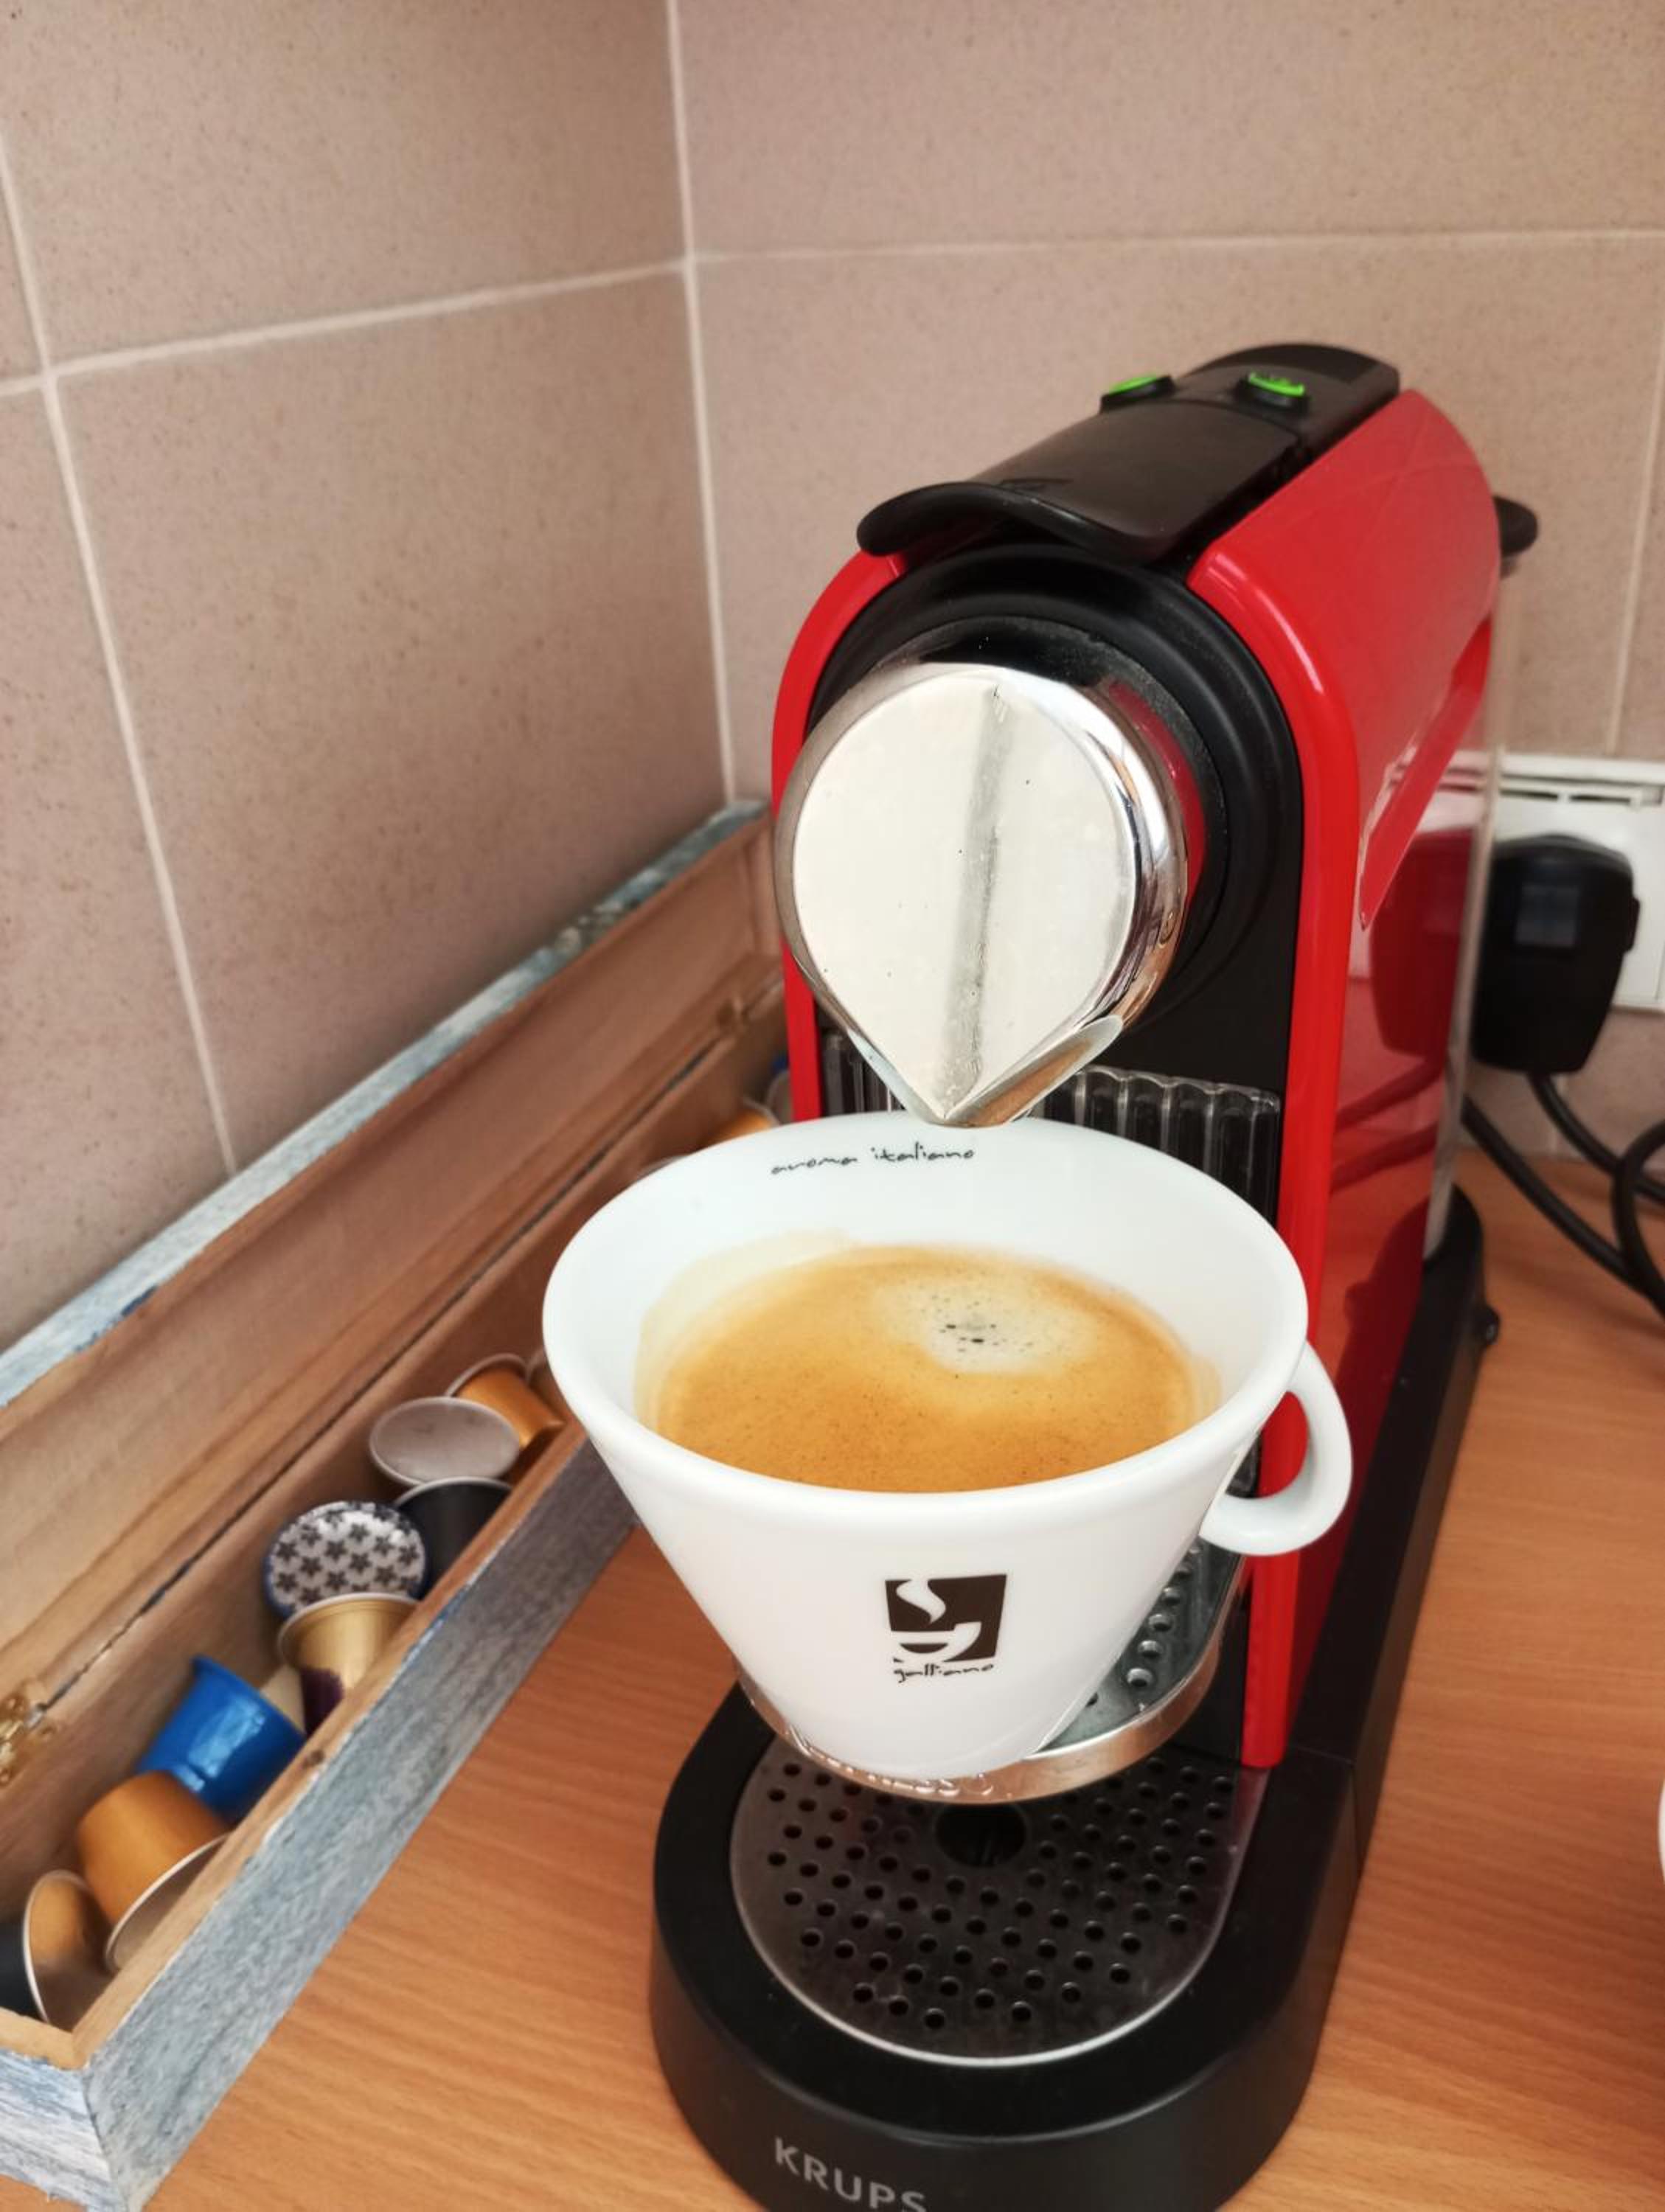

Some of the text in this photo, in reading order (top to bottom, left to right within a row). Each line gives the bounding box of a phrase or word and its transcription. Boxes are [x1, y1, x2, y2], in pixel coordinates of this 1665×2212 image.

[771, 1141, 975, 1175] aroma italiano
[775, 2136, 927, 2212] KRUPS
